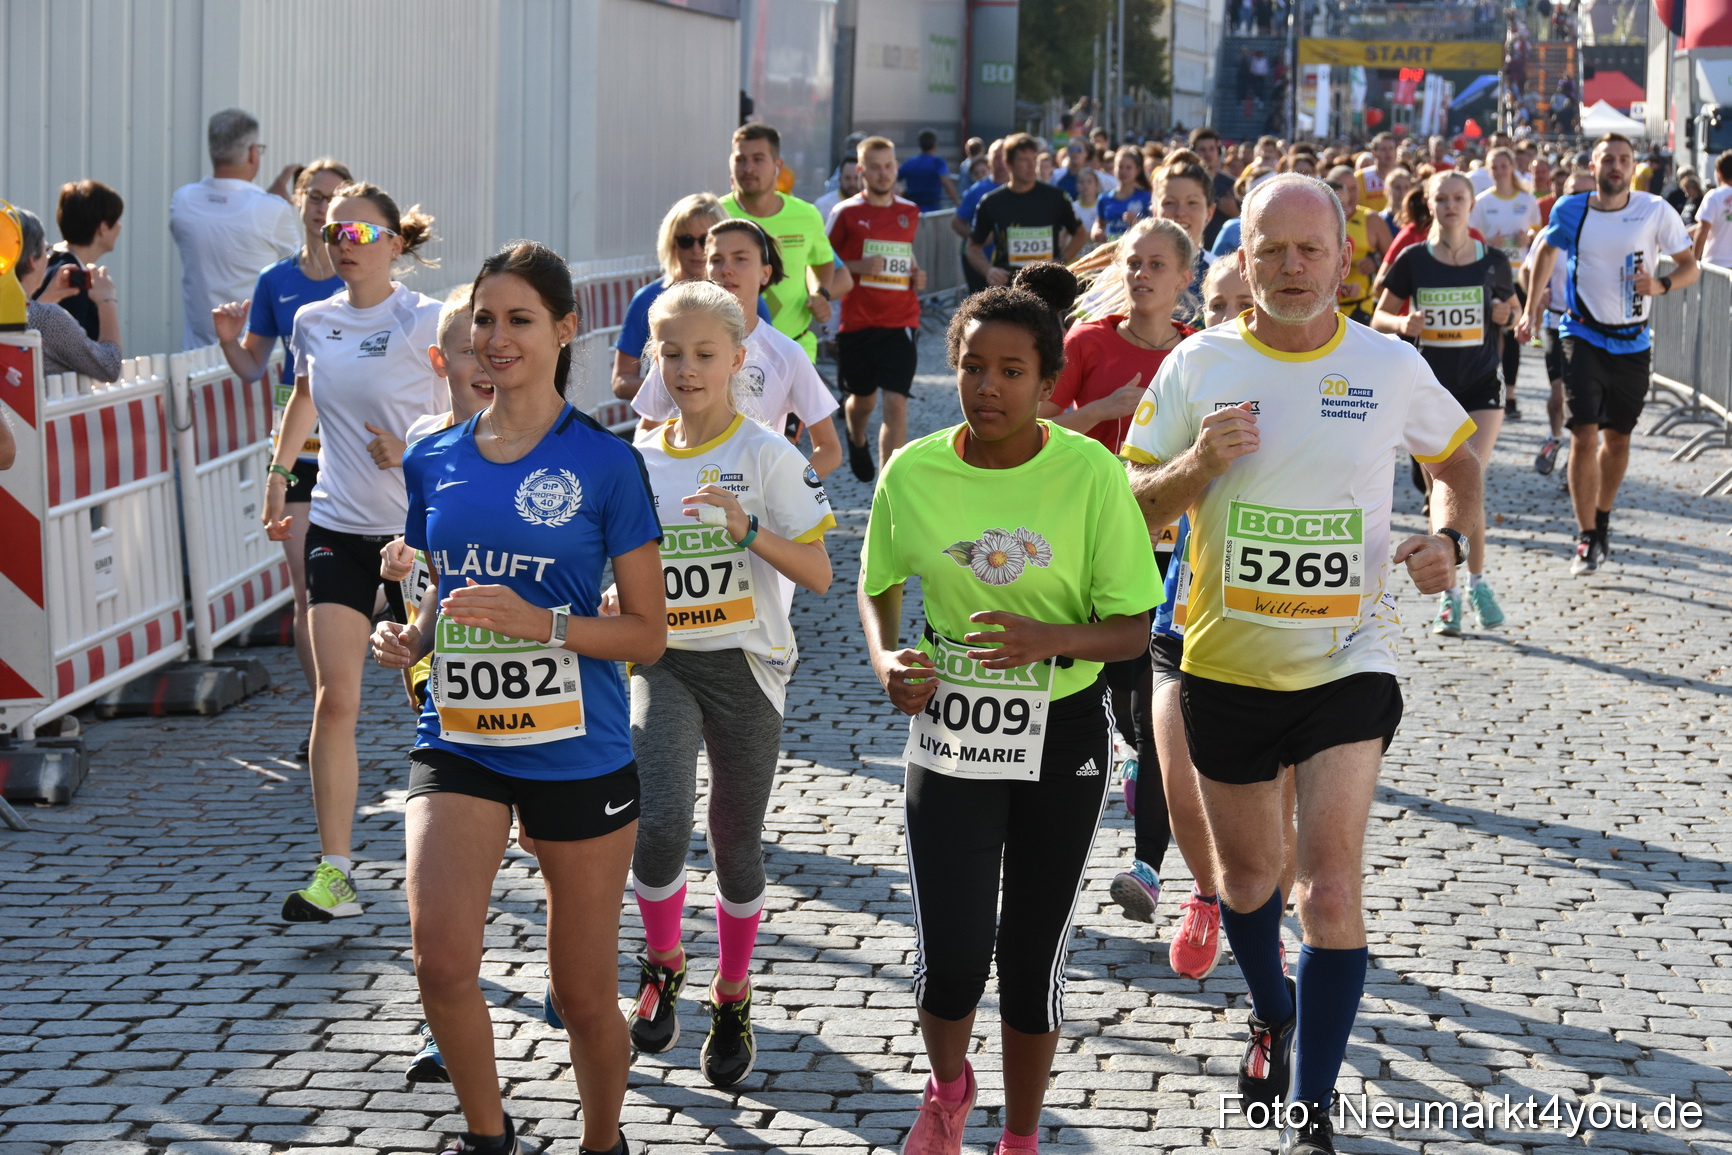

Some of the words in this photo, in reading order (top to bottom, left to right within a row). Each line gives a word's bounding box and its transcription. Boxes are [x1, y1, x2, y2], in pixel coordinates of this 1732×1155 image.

[1365, 44, 1435, 63] START
[1013, 240, 1048, 252] 5203
[882, 258, 906, 273] 188
[1421, 289, 1478, 304] BOCK
[1424, 308, 1475, 326] 5105
[1323, 379, 1347, 396] 20
[1349, 389, 1371, 397] JAHRE
[1321, 398, 1378, 409] Neumarkter
[1320, 409, 1367, 422] Stadtlauf
[699, 469, 720, 484] 20
[540, 499, 554, 507] 40
[1237, 506, 1354, 541] BOCK
[660, 527, 730, 555] OCK
[433, 543, 555, 582] #LÄUFT
[1238, 546, 1348, 588] 5269
[664, 561, 733, 600] 007
[1255, 596, 1329, 617] Willfried
[667, 608, 727, 627] OPHIA
[446, 657, 561, 701] 5082
[925, 687, 1030, 736] 4009
[476, 713, 536, 730] ANJA
[919, 733, 1027, 763] LIYA-MARIE
